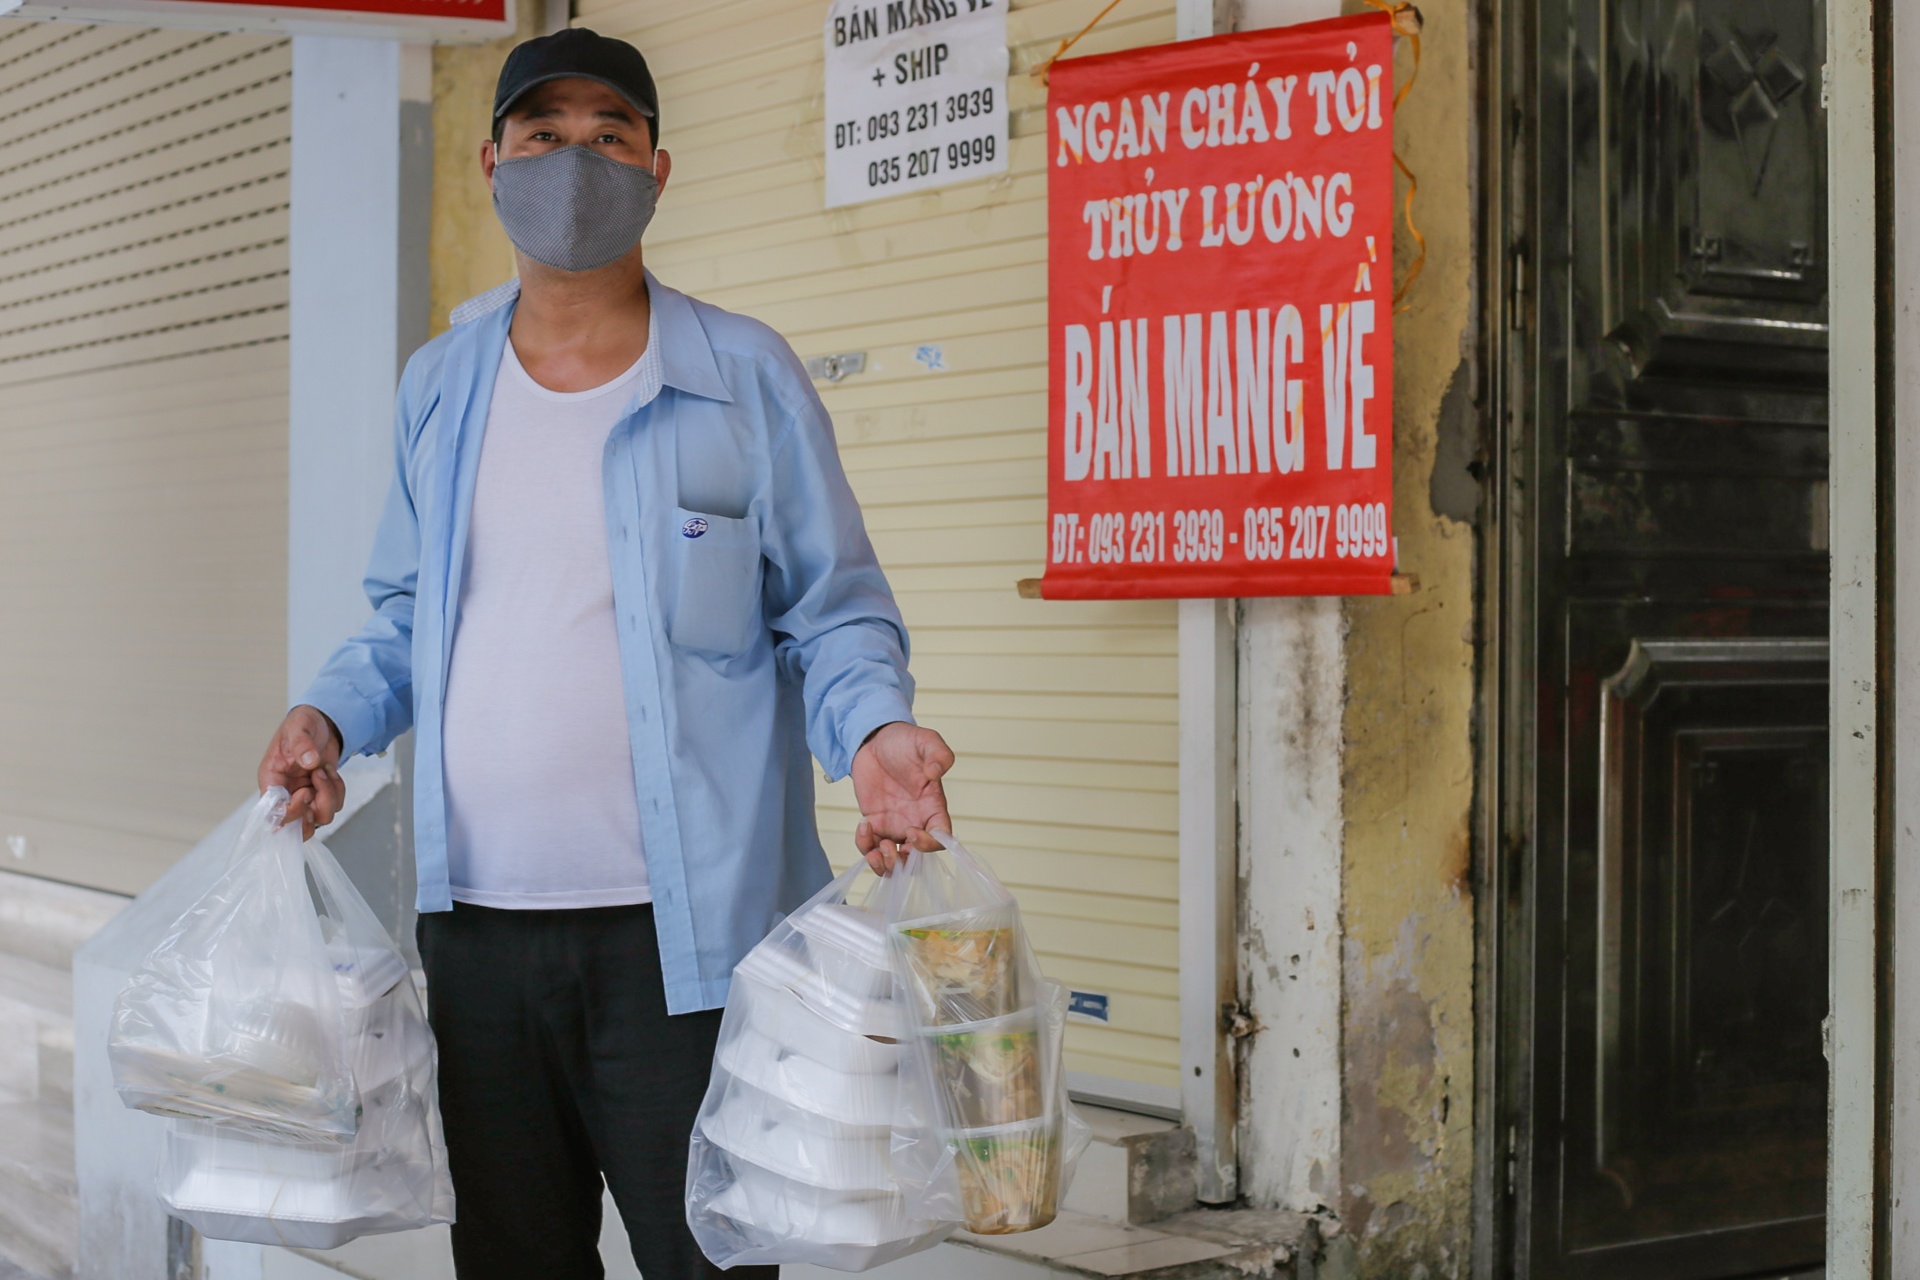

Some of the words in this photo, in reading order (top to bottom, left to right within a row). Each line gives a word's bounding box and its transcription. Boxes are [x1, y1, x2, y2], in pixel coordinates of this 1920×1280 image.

[834, 6, 878, 47] BÁN
[894, 43, 949, 85] SHIP
[867, 110, 899, 141] 093
[906, 101, 938, 132] 231
[946, 87, 994, 122] 3939
[1056, 91, 1170, 167] NGAN
[1180, 62, 1298, 150] CHÁY
[1307, 41, 1383, 136] TỎI
[868, 156, 900, 187] 035
[907, 147, 940, 179] 207
[947, 134, 996, 169] 9999
[1083, 167, 1190, 260] THỦY
[1199, 171, 1354, 247] LƯƠNG
[1064, 285, 1151, 481] BÁN
[1163, 304, 1304, 477] MANG
[1052, 513, 1084, 564] ĐT:
[1088, 512, 1125, 564] 093
[1130, 511, 1165, 563] 231
[1173, 509, 1224, 562] 3939
[1244, 507, 1284, 561] 035
[1290, 506, 1331, 559] 207
[1336, 502, 1388, 559] 9999
